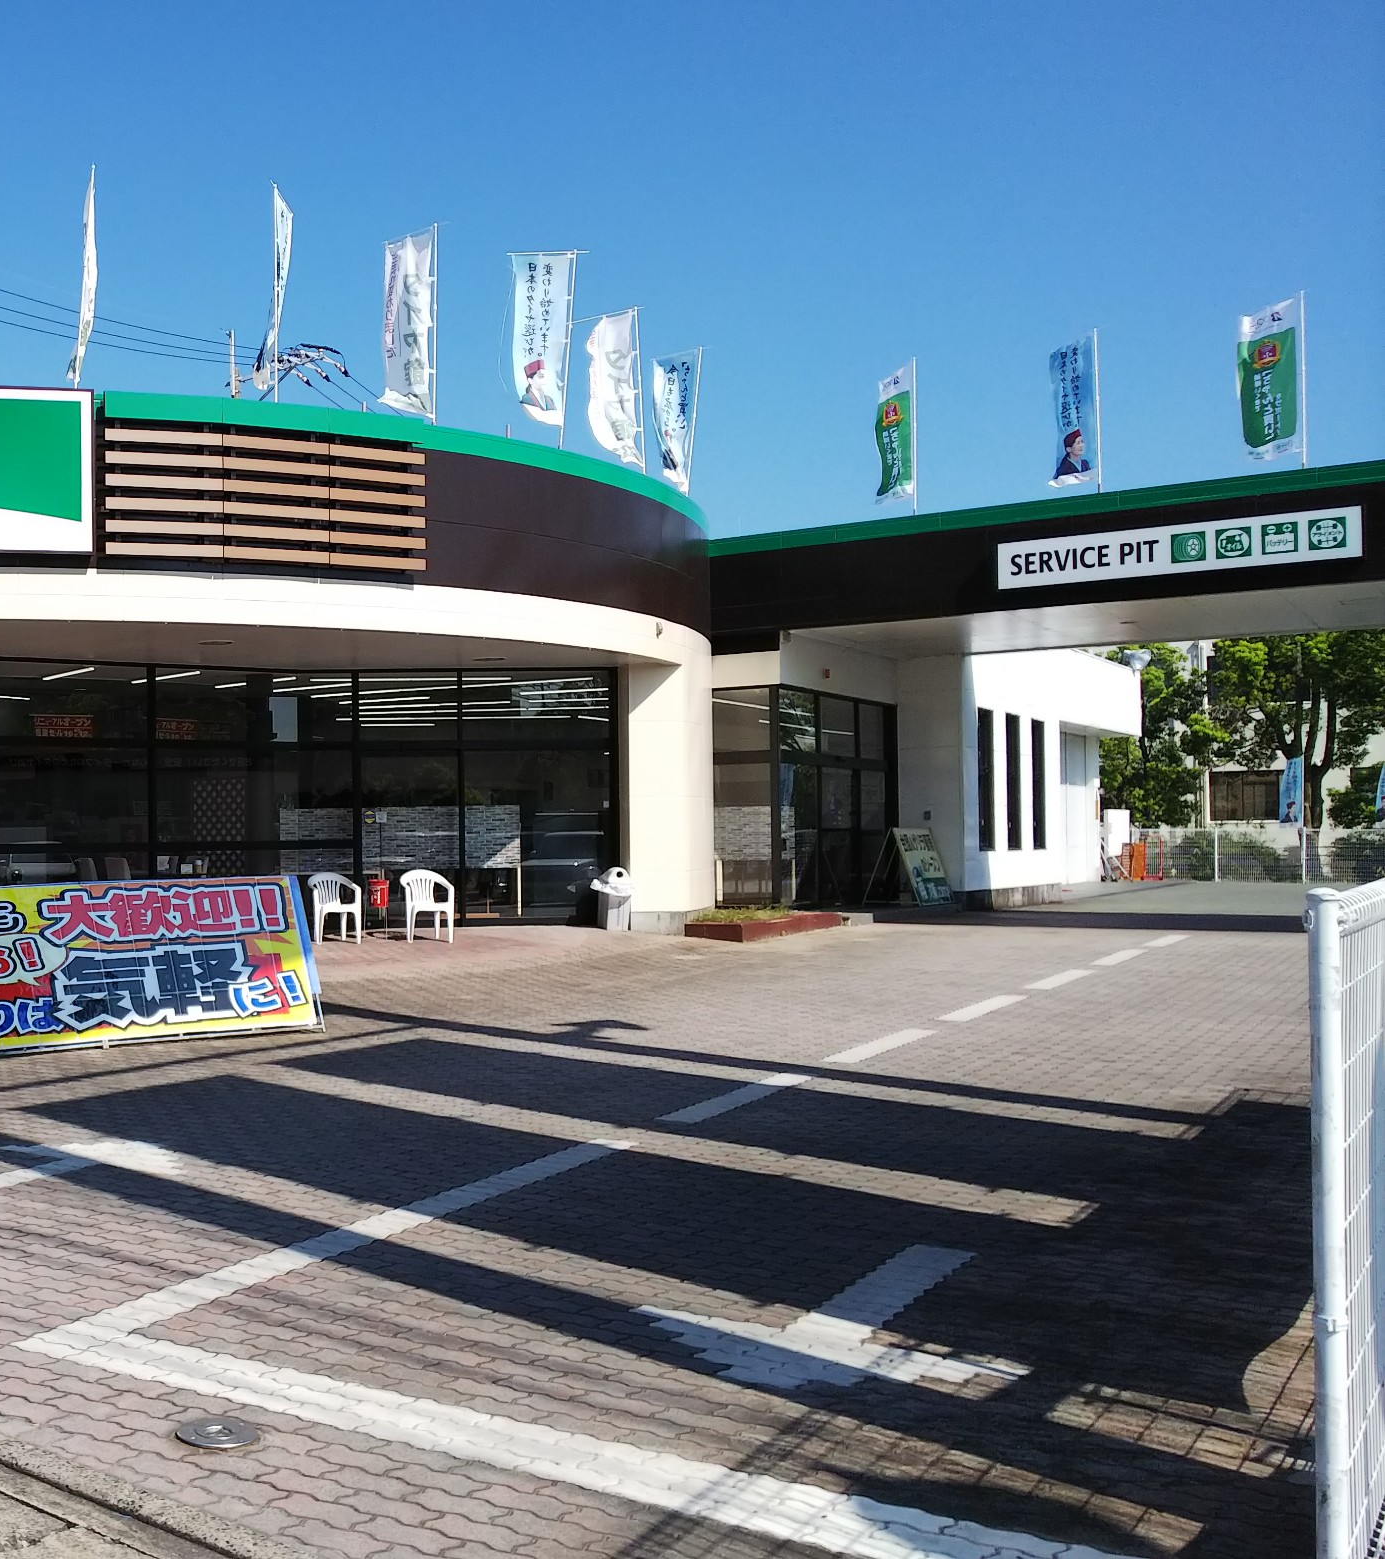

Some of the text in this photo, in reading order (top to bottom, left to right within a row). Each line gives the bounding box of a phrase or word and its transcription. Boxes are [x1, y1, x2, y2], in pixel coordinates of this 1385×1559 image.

[1311, 530, 1343, 538] アライメント
[1225, 541, 1243, 550] オイル
[1266, 538, 1294, 547] バッテリー
[1010, 540, 1160, 577] SERVICE PIT
